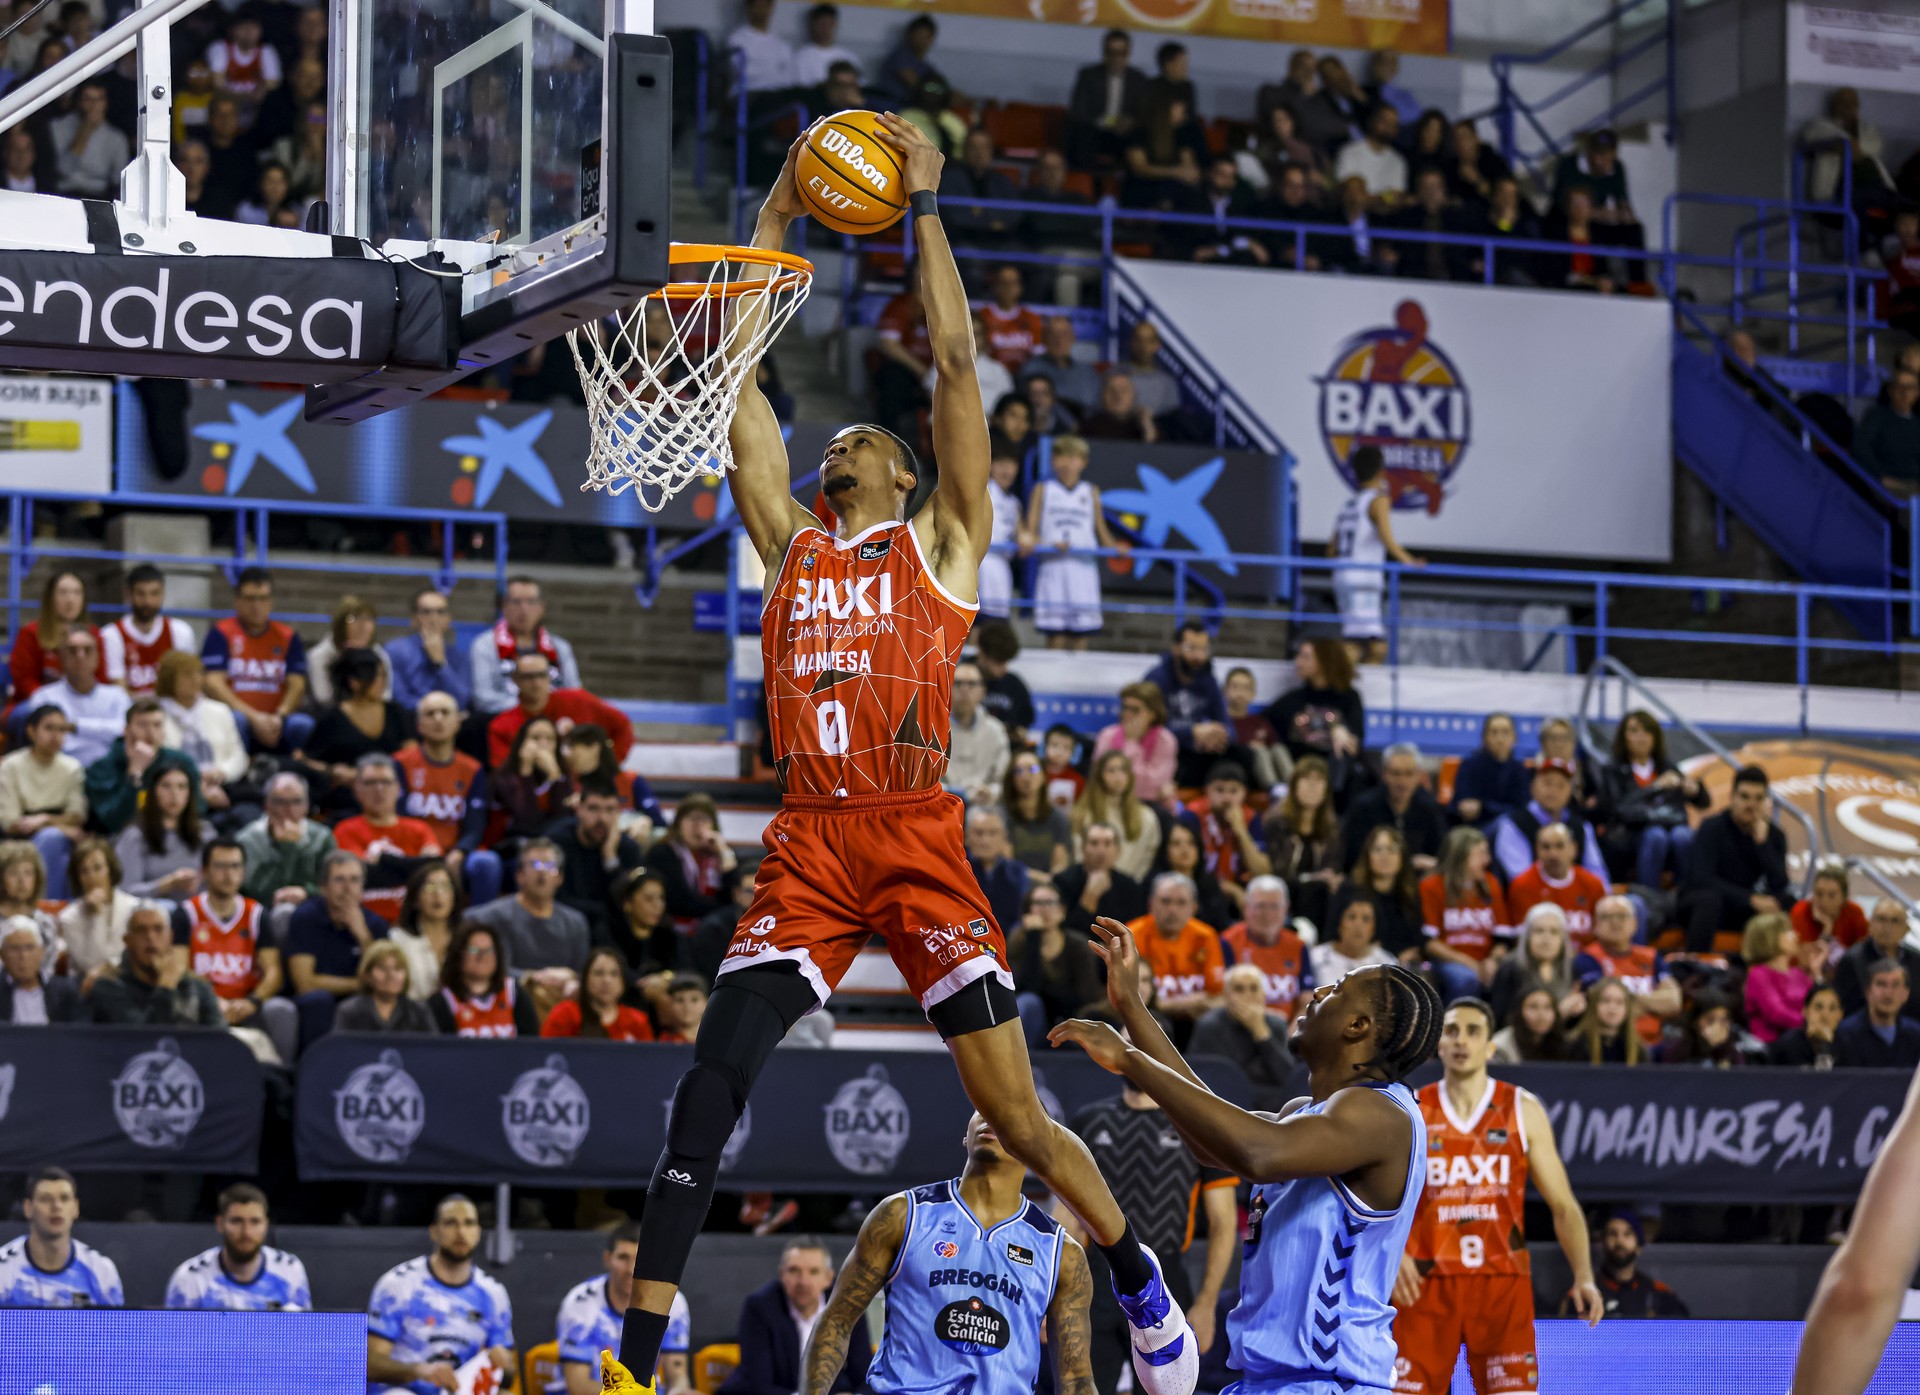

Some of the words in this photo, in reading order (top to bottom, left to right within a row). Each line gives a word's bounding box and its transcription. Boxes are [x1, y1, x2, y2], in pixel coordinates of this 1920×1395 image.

[820, 127, 889, 193] Wilson
[1326, 382, 1465, 441] BAXI
[790, 572, 893, 622] BAXI
[816, 700, 850, 755] 0
[120, 1084, 198, 1110] BAXI
[343, 1095, 418, 1121] BAXI
[509, 1101, 585, 1126] BAXI
[833, 1109, 903, 1134] BAXI
[1426, 1154, 1511, 1187] BAXI
[1459, 1234, 1485, 1268] 8
[928, 1268, 1023, 1306] BREOGÁN
[947, 1309, 1000, 1332] Estrella
[947, 1323, 997, 1345] Galicia
